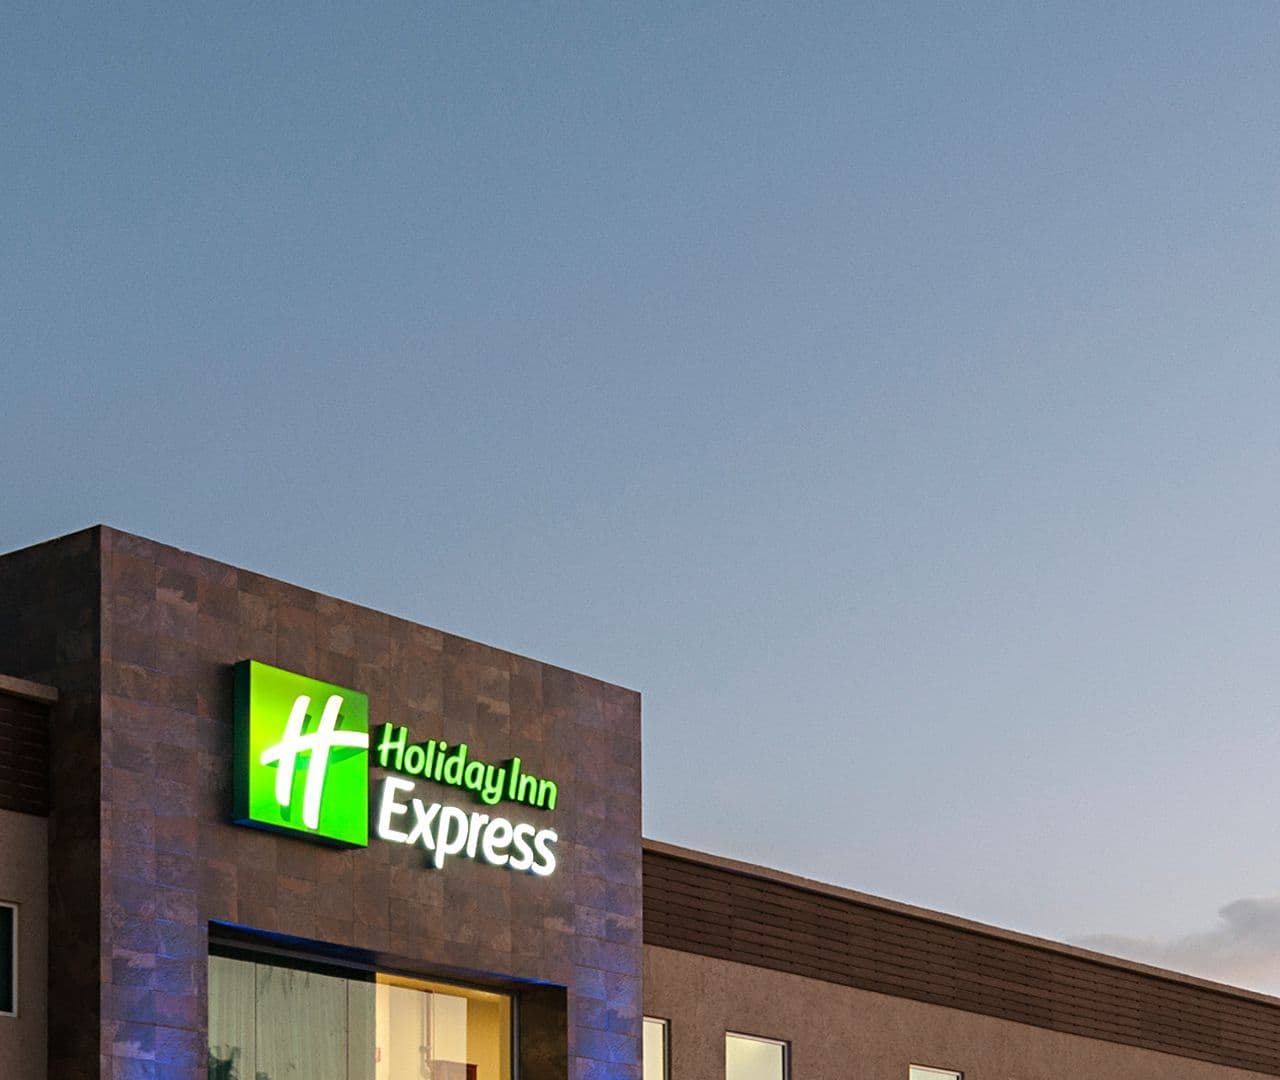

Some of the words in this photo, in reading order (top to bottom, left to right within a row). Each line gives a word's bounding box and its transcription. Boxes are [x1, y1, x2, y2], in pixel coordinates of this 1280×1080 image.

[376, 721, 505, 806] Holiday
[507, 755, 558, 811] Inn
[378, 776, 558, 876] Express
